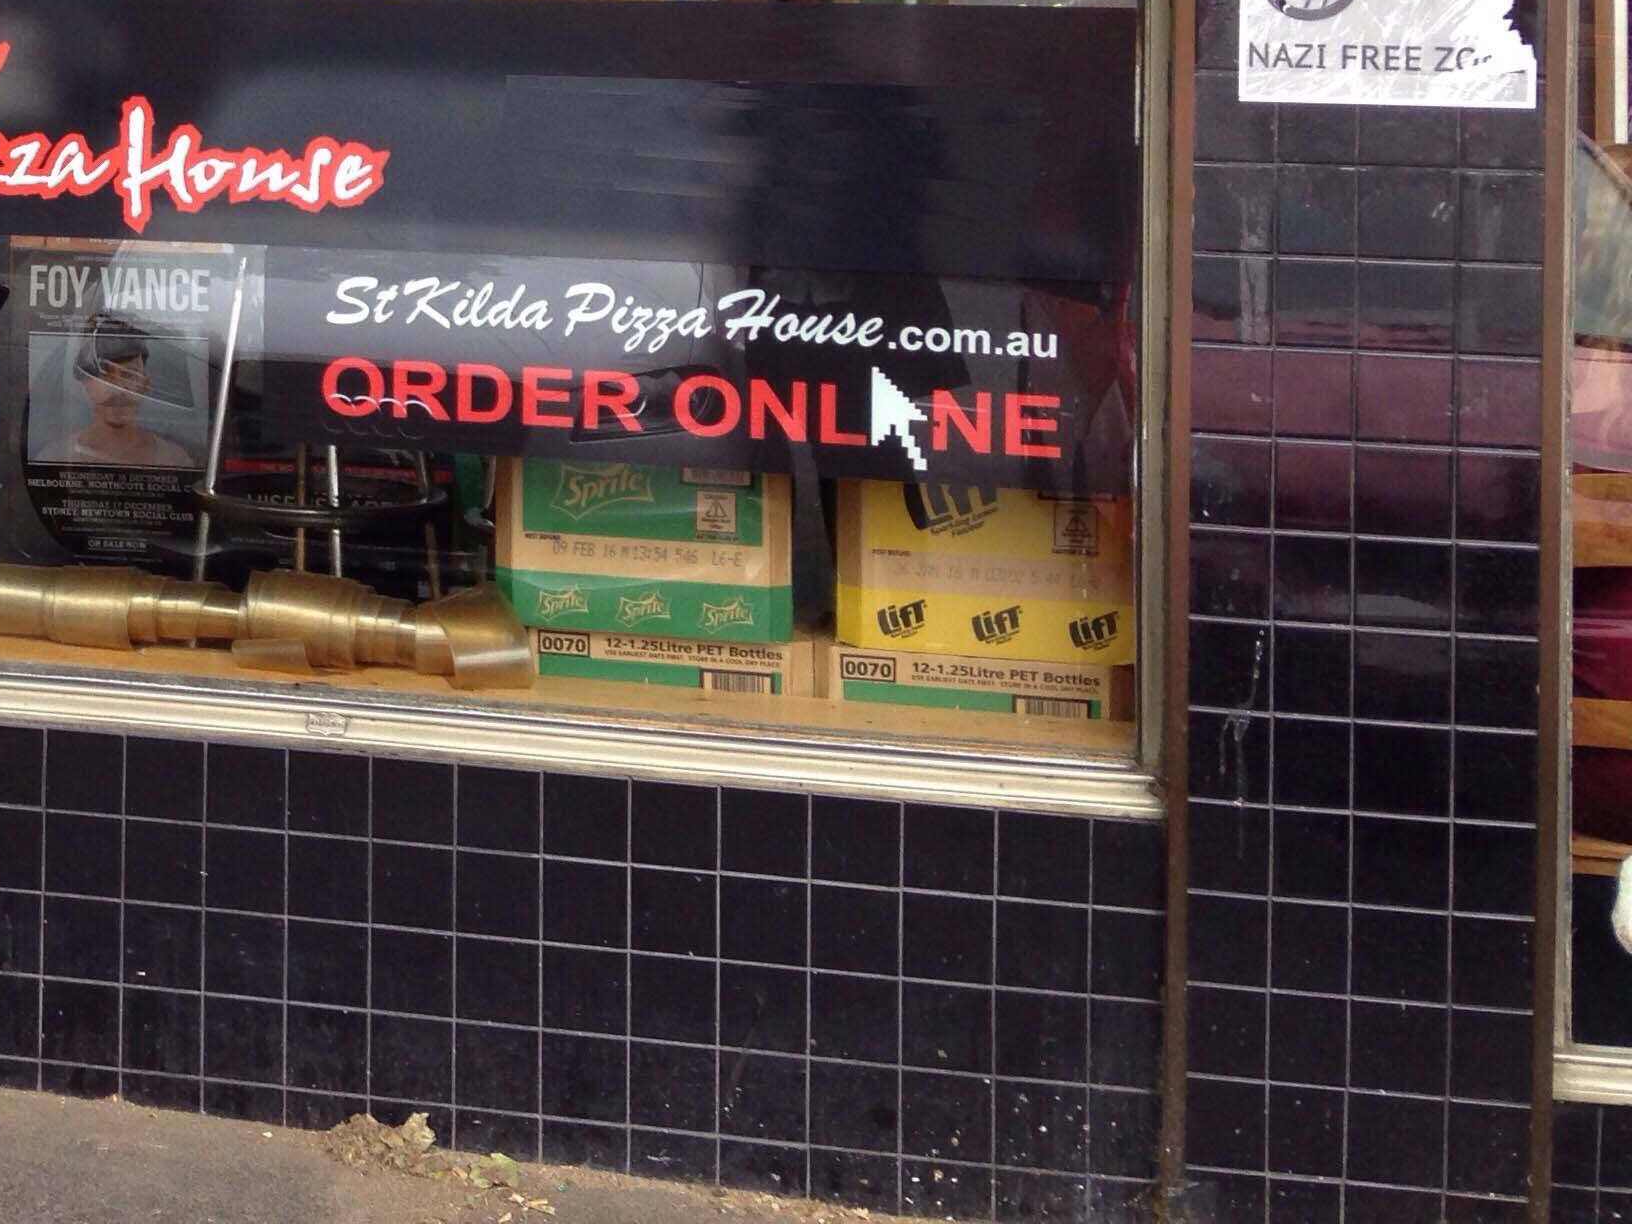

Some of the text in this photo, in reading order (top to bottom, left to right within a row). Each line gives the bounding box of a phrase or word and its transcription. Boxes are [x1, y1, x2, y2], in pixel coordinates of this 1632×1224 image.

[1247, 41, 1327, 70] NAZI
[1341, 43, 1422, 72] FREE
[119, 102, 378, 222] House
[29, 264, 210, 312] FOY VANCE
[321, 355, 1062, 458] ORDER ONLNE
[564, 468, 644, 507] Sprite
[573, 542, 595, 557] FEB
[542, 592, 583, 615] Sprite
[624, 597, 666, 620] Sprite
[706, 604, 750, 627] Sprite
[542, 636, 586, 653] 0070
[696, 642, 724, 656] PET
[728, 646, 783, 662] Bottles
[844, 660, 891, 678] 0070
[1009, 667, 1038, 682] PET
[1043, 670, 1101, 687] Bottles
